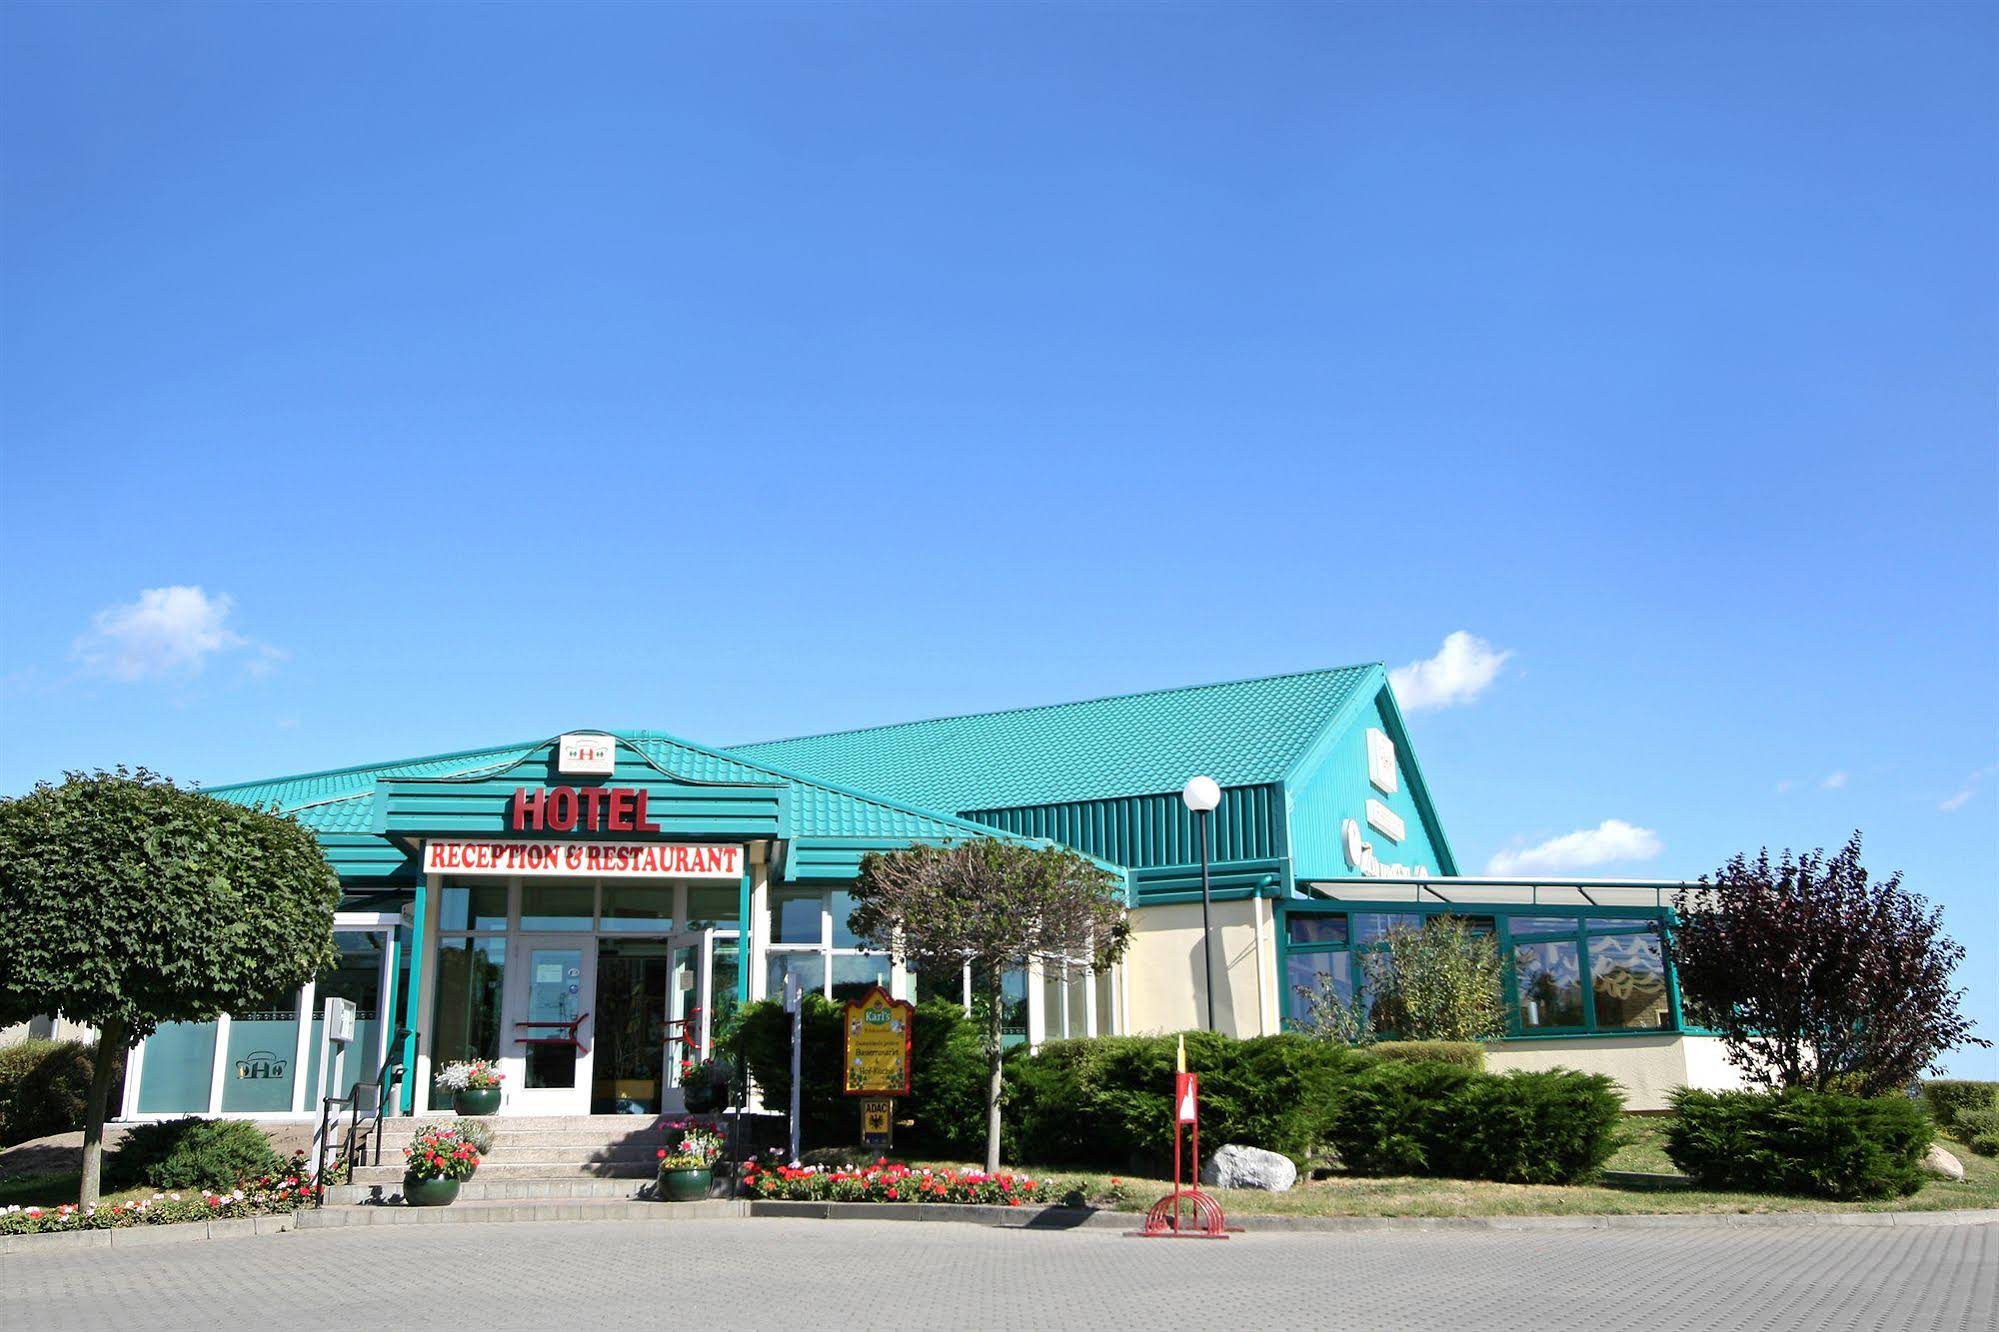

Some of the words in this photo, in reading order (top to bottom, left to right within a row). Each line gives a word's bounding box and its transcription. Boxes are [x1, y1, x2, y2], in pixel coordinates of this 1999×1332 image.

[513, 786, 660, 832] HOTEL
[430, 843, 558, 870] RECEPTION
[565, 845, 582, 870] &
[587, 845, 738, 873] RESTAURANT
[865, 1010, 890, 1021] Karl's
[866, 1103, 887, 1112] ADAC
